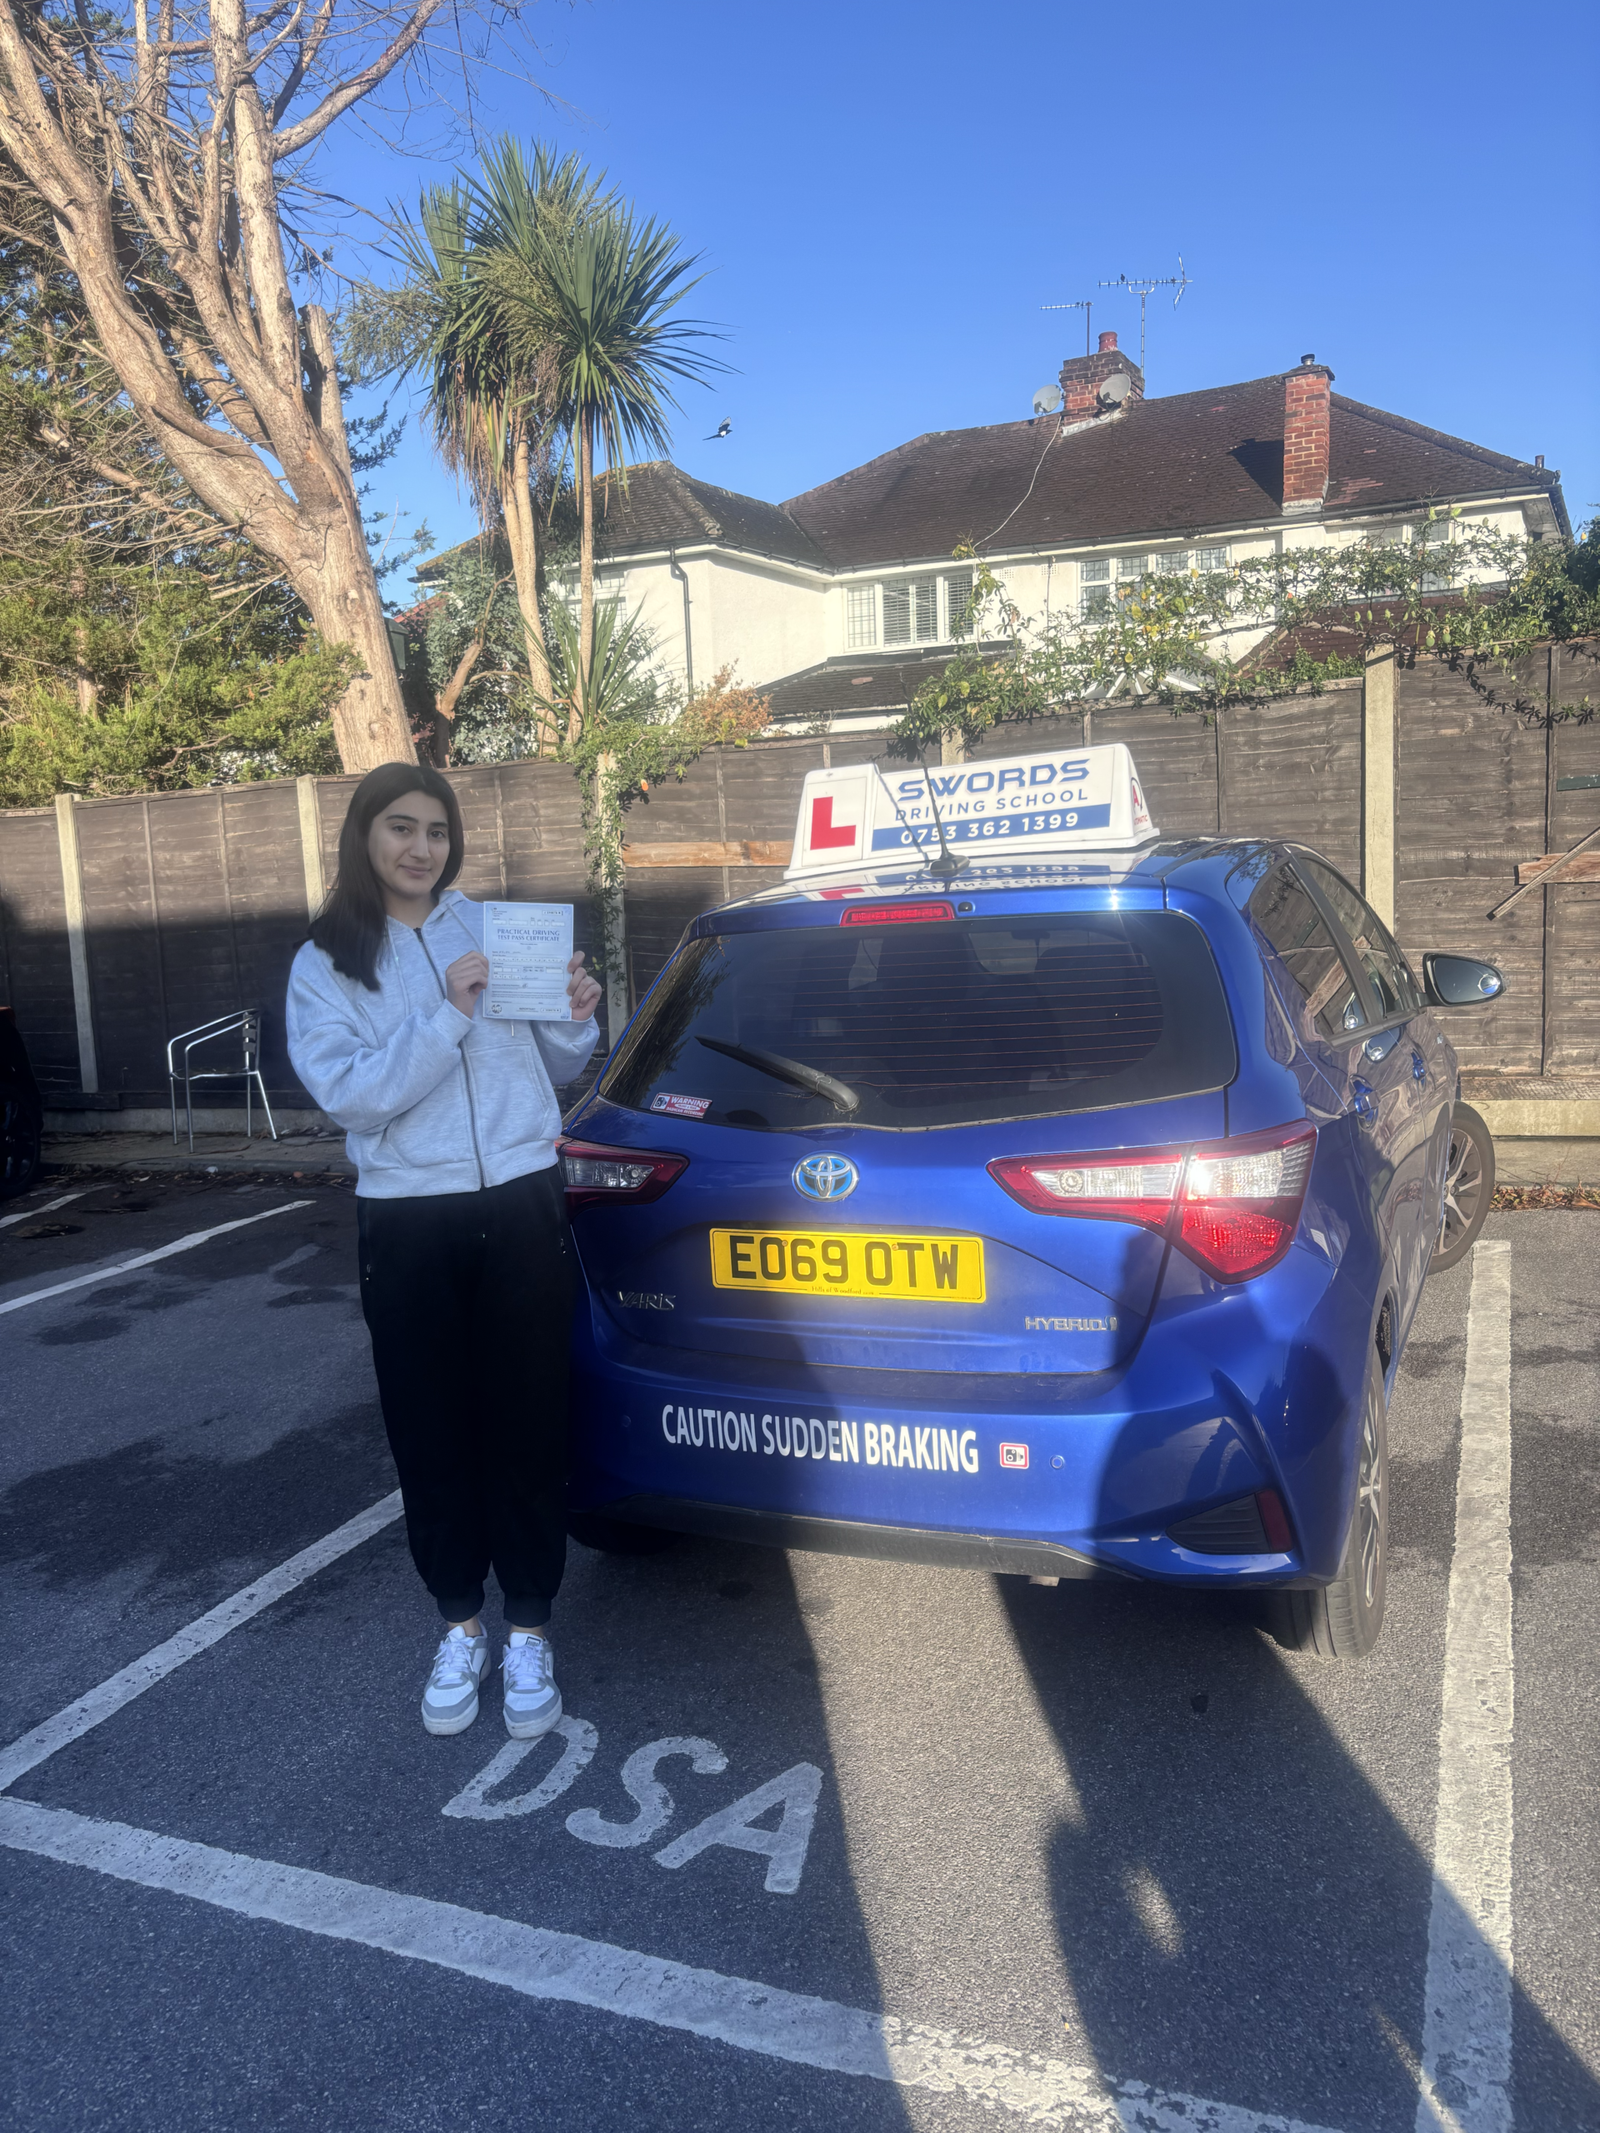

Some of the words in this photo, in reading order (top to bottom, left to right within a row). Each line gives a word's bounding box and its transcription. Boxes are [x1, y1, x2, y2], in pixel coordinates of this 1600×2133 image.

[897, 758, 1090, 802] SWORDS
[996, 788, 1088, 810] SCHOOL
[810, 796, 856, 850] L
[901, 824, 957, 845] 0753
[968, 815, 1010, 837] 362
[1023, 812, 1079, 832] 1399
[497, 928, 531, 936] PRACTICAL
[671, 1096, 710, 1108] WARNING
[730, 1234, 849, 1283] EO69
[864, 1241, 959, 1290] OTW
[1025, 1316, 1102, 1331] HYBRID
[661, 1404, 757, 1453] CAUTION
[762, 1413, 859, 1463] SUDDEN
[864, 1422, 980, 1474] BRAKING
[441, 1714, 824, 1894] DSA
